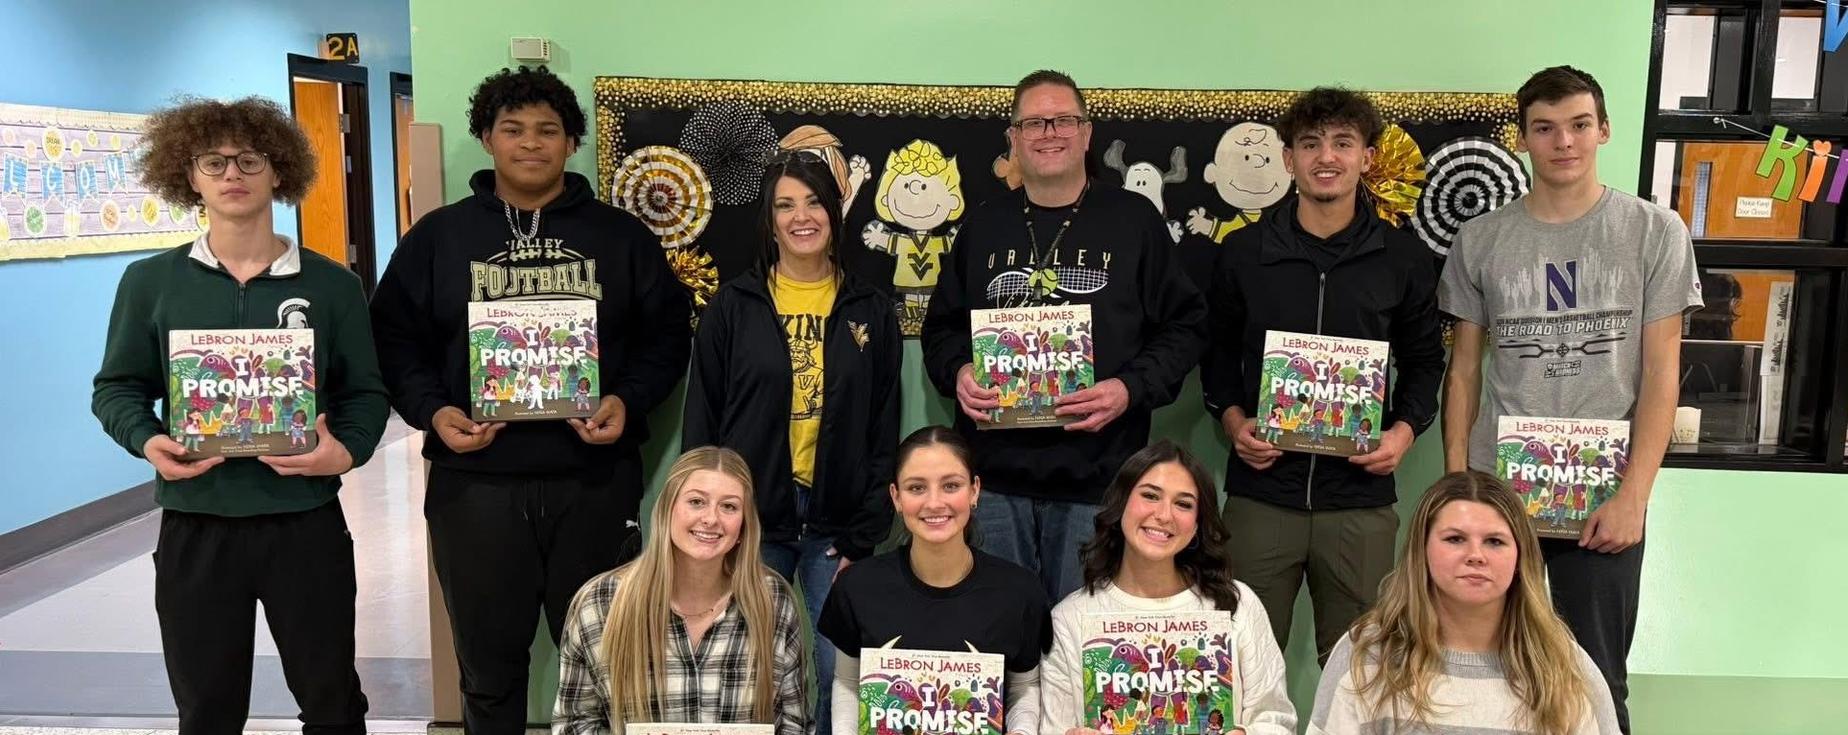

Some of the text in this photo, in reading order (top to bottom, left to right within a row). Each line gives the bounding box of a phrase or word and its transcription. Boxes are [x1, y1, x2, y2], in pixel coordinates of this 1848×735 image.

[327, 36, 359, 60] 2A
[470, 259, 603, 301] FOOTBALL
[1546, 260, 1577, 312] N
[1037, 310, 1075, 322] JAMES
[1520, 324, 1553, 336] ROAD
[1558, 322, 1573, 334] TO
[1575, 317, 1629, 334] PHOENIX
[250, 333, 294, 346] JAMES
[527, 330, 539, 346] I
[1025, 335, 1038, 352] I
[480, 346, 588, 367] PROMISE
[1331, 341, 1370, 356] JAMES
[236, 357, 248, 376] I
[983, 351, 1085, 373] PROMISE
[1316, 363, 1328, 381] I
[182, 376, 304, 398] PROMISE
[798, 374, 815, 390] V
[1270, 377, 1373, 405] PROMISE
[1568, 423, 1610, 436] JAMES
[1553, 446, 1566, 463] I
[1506, 462, 1617, 487] PROMISE
[1162, 620, 1209, 634] JAMES
[937, 659, 982, 674] JAMES
[1148, 648, 1162, 669] I
[1095, 669, 1221, 694] PROMISE
[921, 687, 936, 707] I
[869, 707, 989, 735] PROMISE
